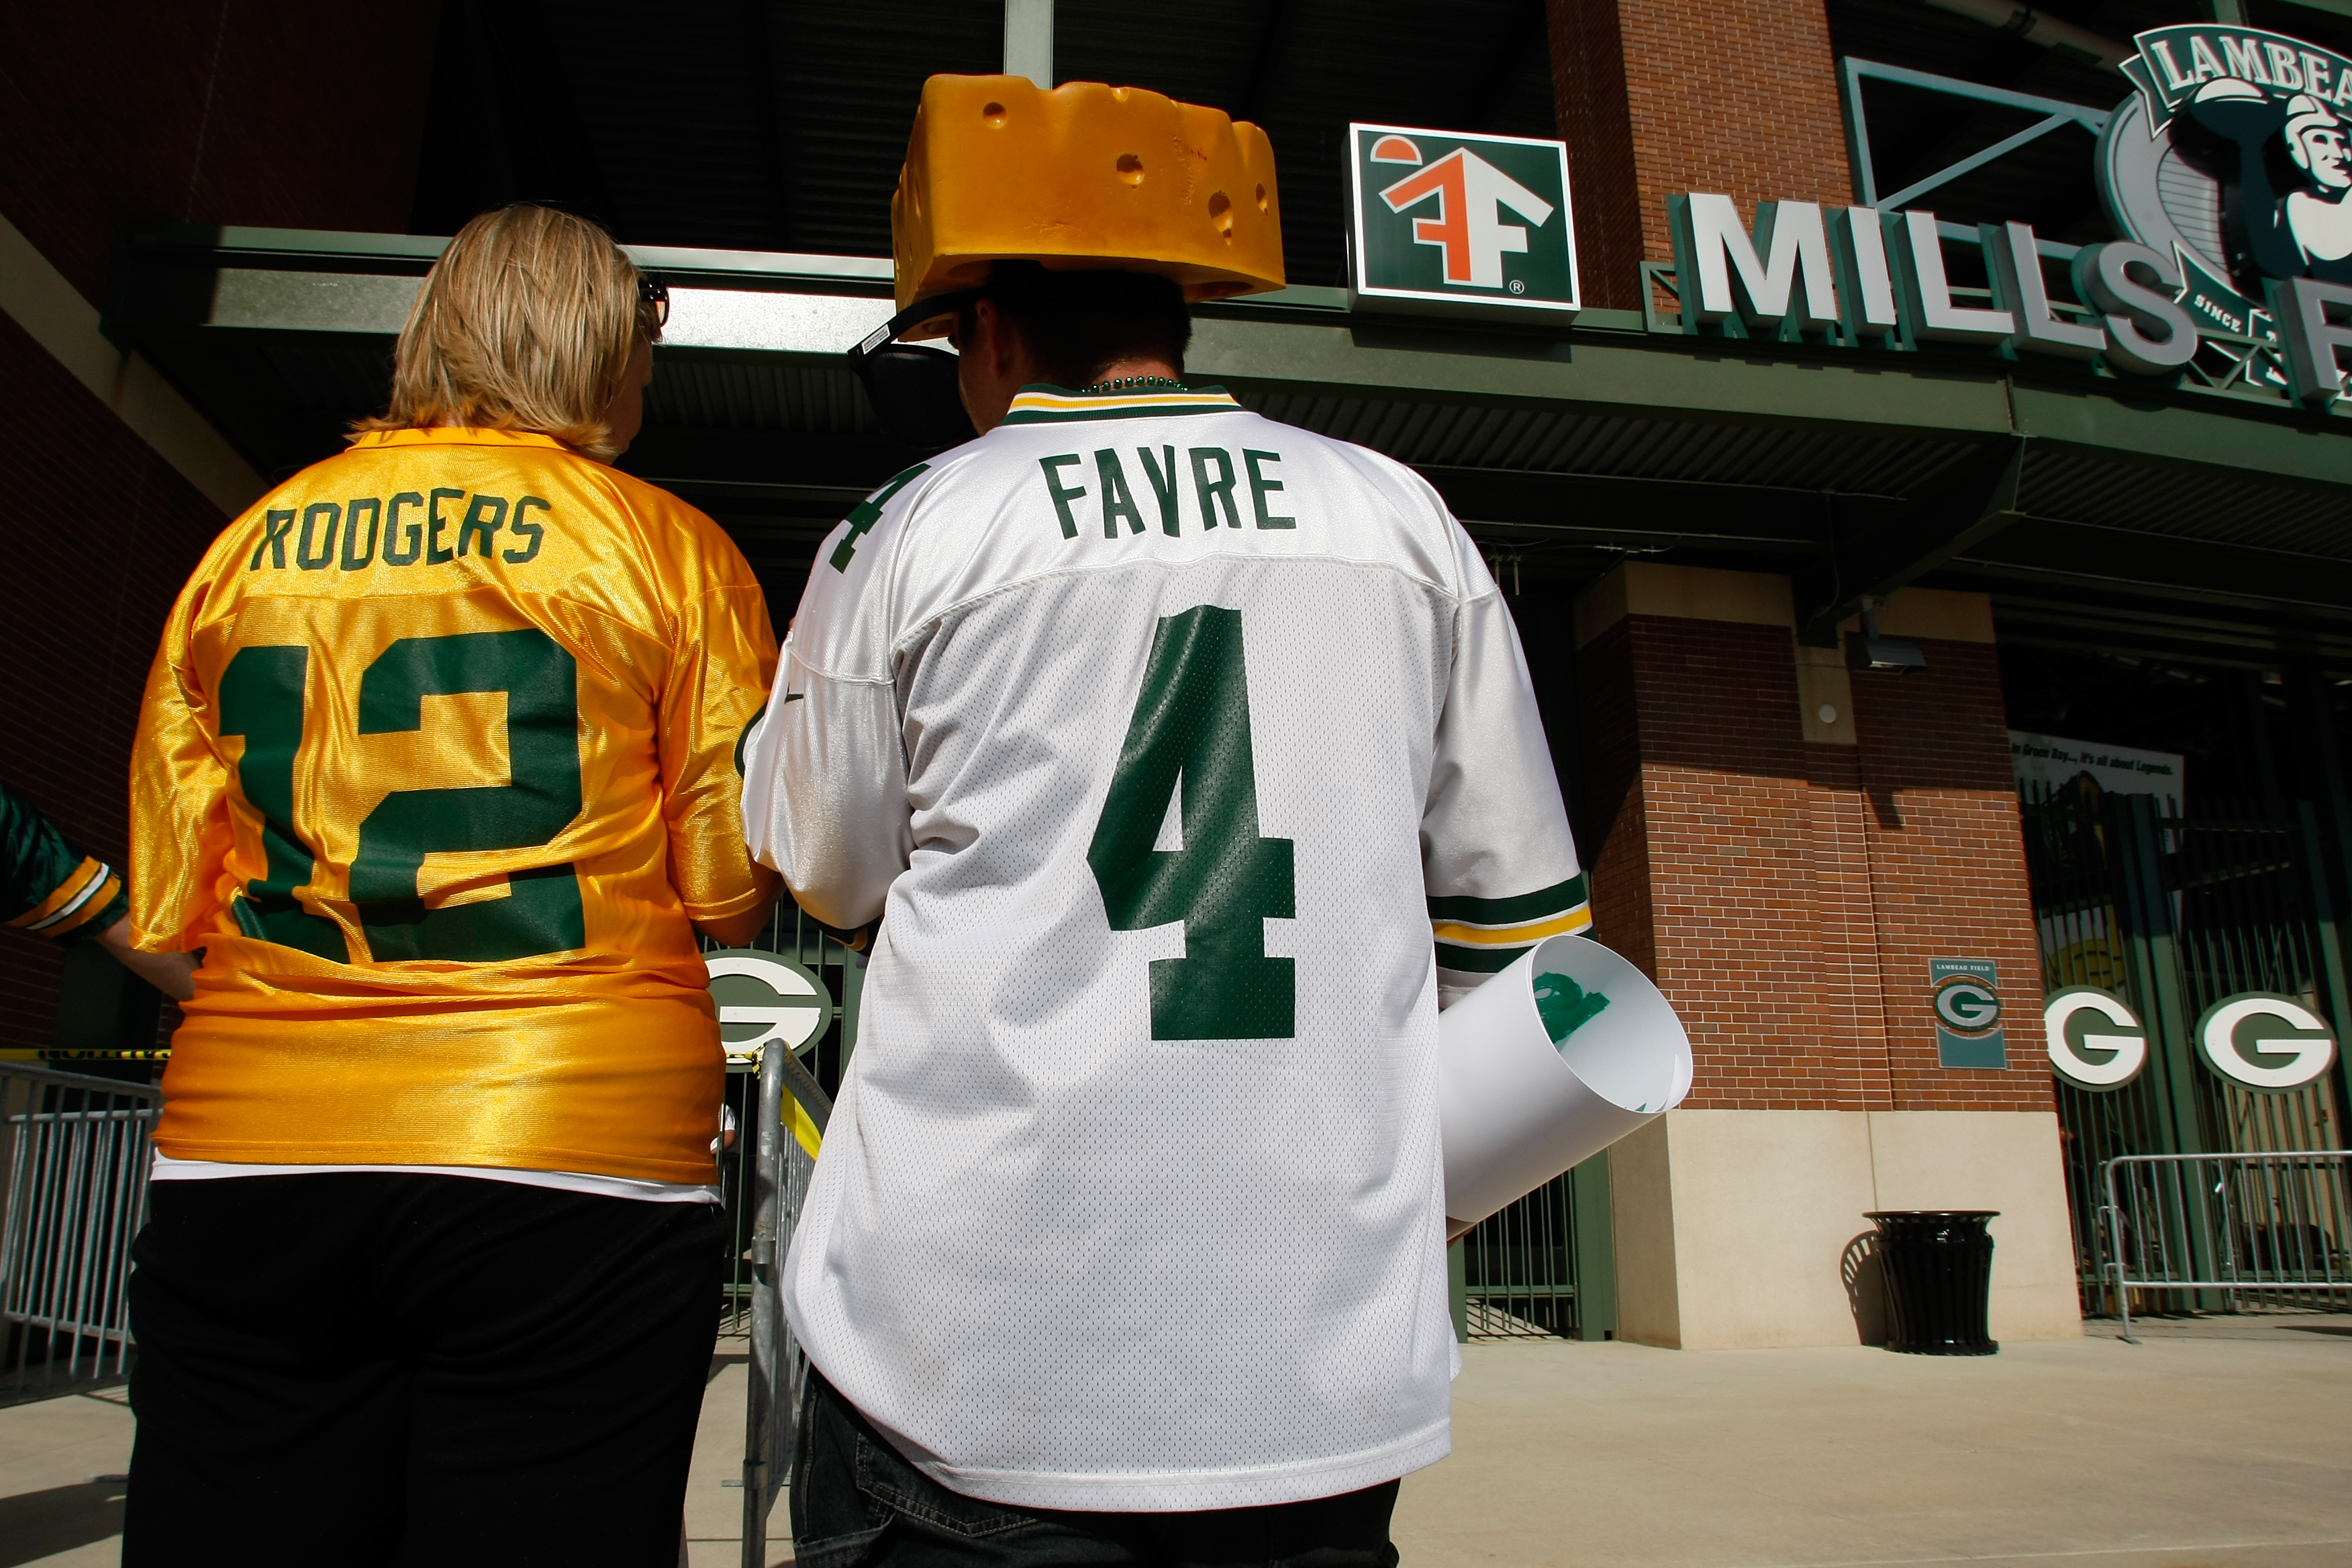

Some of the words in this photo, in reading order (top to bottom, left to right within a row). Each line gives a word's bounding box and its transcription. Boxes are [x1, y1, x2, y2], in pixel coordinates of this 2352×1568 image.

[1687, 192, 2198, 365] MILLS
[2194, 294, 2243, 333] SINCE
[250, 487, 552, 571] RODGERS
[1039, 444, 1296, 539] FAVRE
[218, 628, 586, 964] 12
[2022, 744, 2049, 758] Green
[2080, 752, 2094, 764] it's
[2096, 755, 2108, 767] all
[2110, 758, 2135, 770] about
[1086, 604, 1296, 1041] 4
[2044, 991, 2145, 1085] G
[2202, 997, 2333, 1088] G
